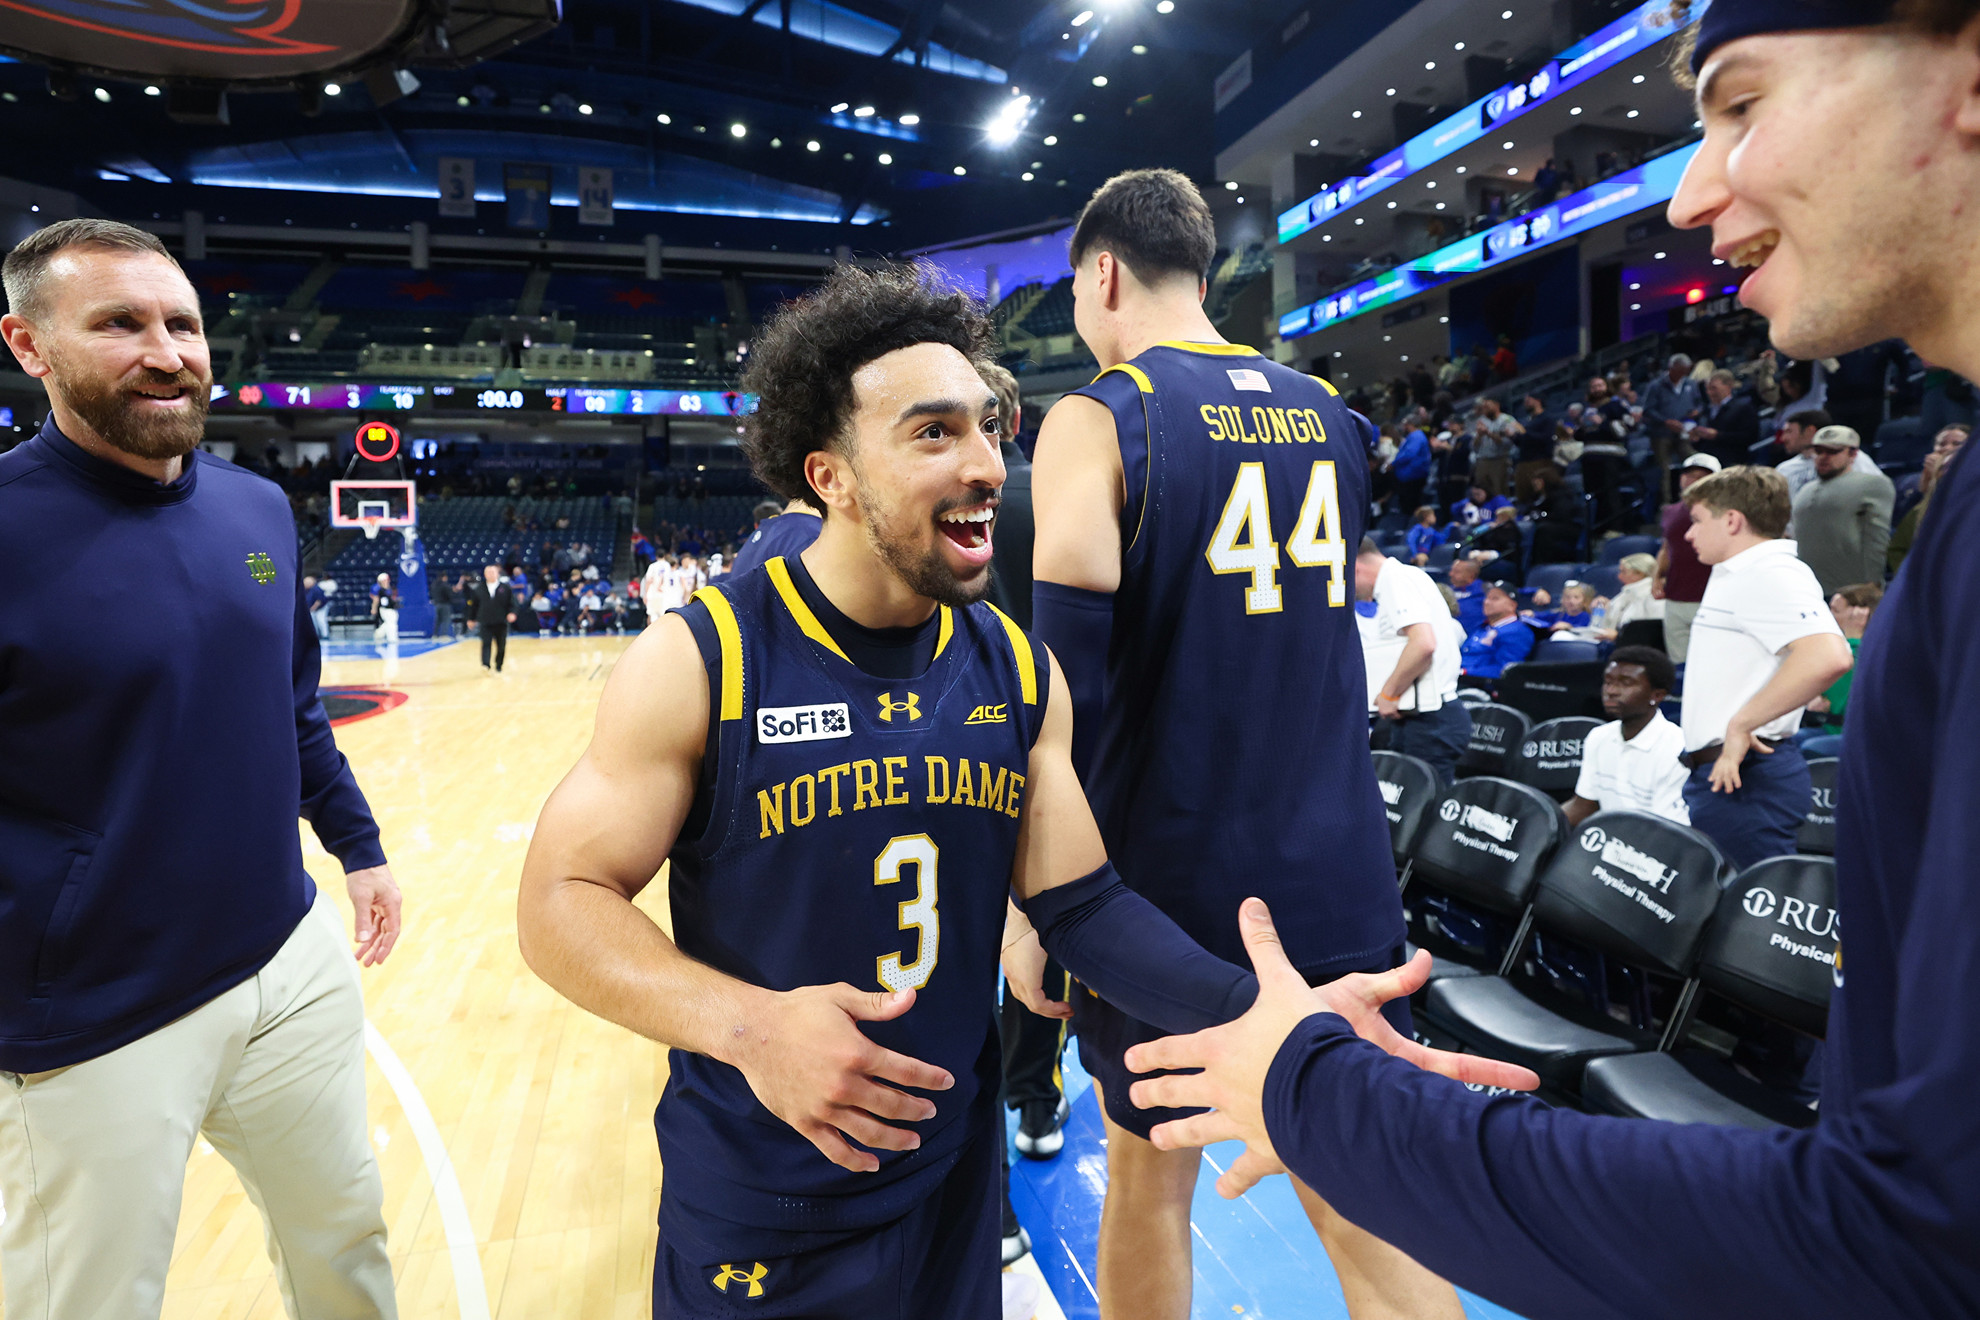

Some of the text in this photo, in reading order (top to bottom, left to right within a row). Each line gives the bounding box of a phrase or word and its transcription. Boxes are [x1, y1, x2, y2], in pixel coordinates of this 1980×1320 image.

[286, 386, 311, 405] 71
[347, 393, 361, 409] 3
[392, 393, 414, 409] 10
[551, 396, 563, 411] 2
[632, 397, 643, 412] 2
[1200, 404, 1327, 444] SOLONGO
[1205, 460, 1347, 615] 44
[762, 711, 817, 737] SoFi
[966, 703, 1008, 722] ACC
[757, 755, 1026, 839] NOTRE DAME
[1592, 865, 1637, 898] Physical
[1635, 889, 1676, 924] Therapy
[874, 833, 940, 993] 3
[1770, 933, 1837, 966] Physical
